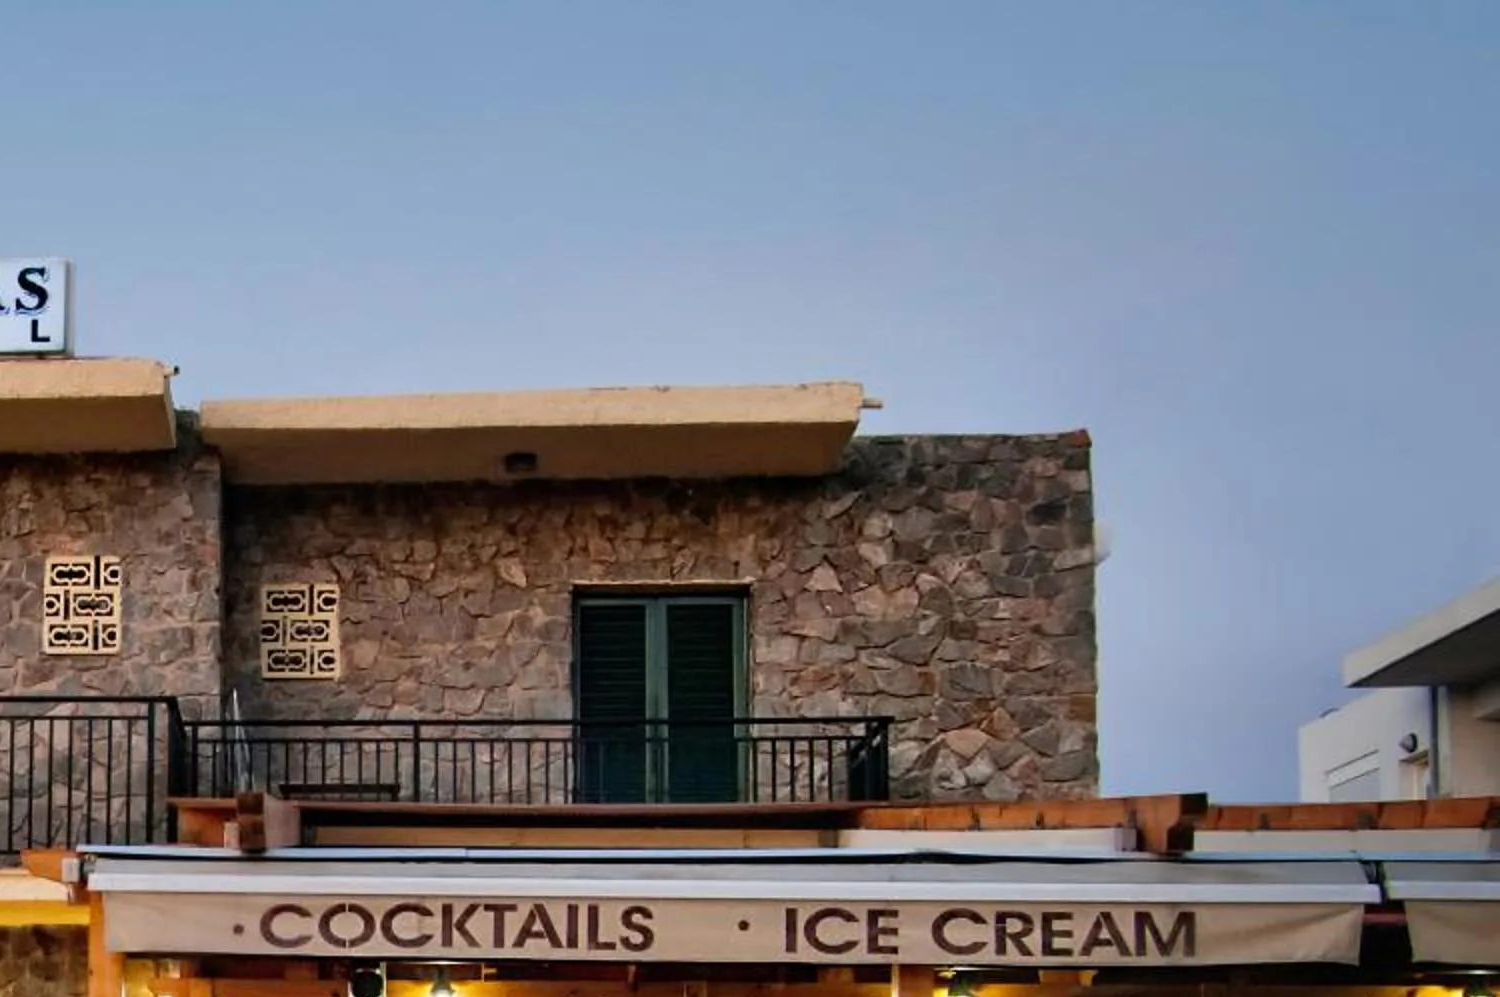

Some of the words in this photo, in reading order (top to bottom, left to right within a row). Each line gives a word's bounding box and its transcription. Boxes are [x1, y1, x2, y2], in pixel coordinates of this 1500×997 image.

[259, 902, 655, 952] COCKTAILS
[784, 907, 899, 955] ICE
[931, 907, 1197, 957] CREAM
